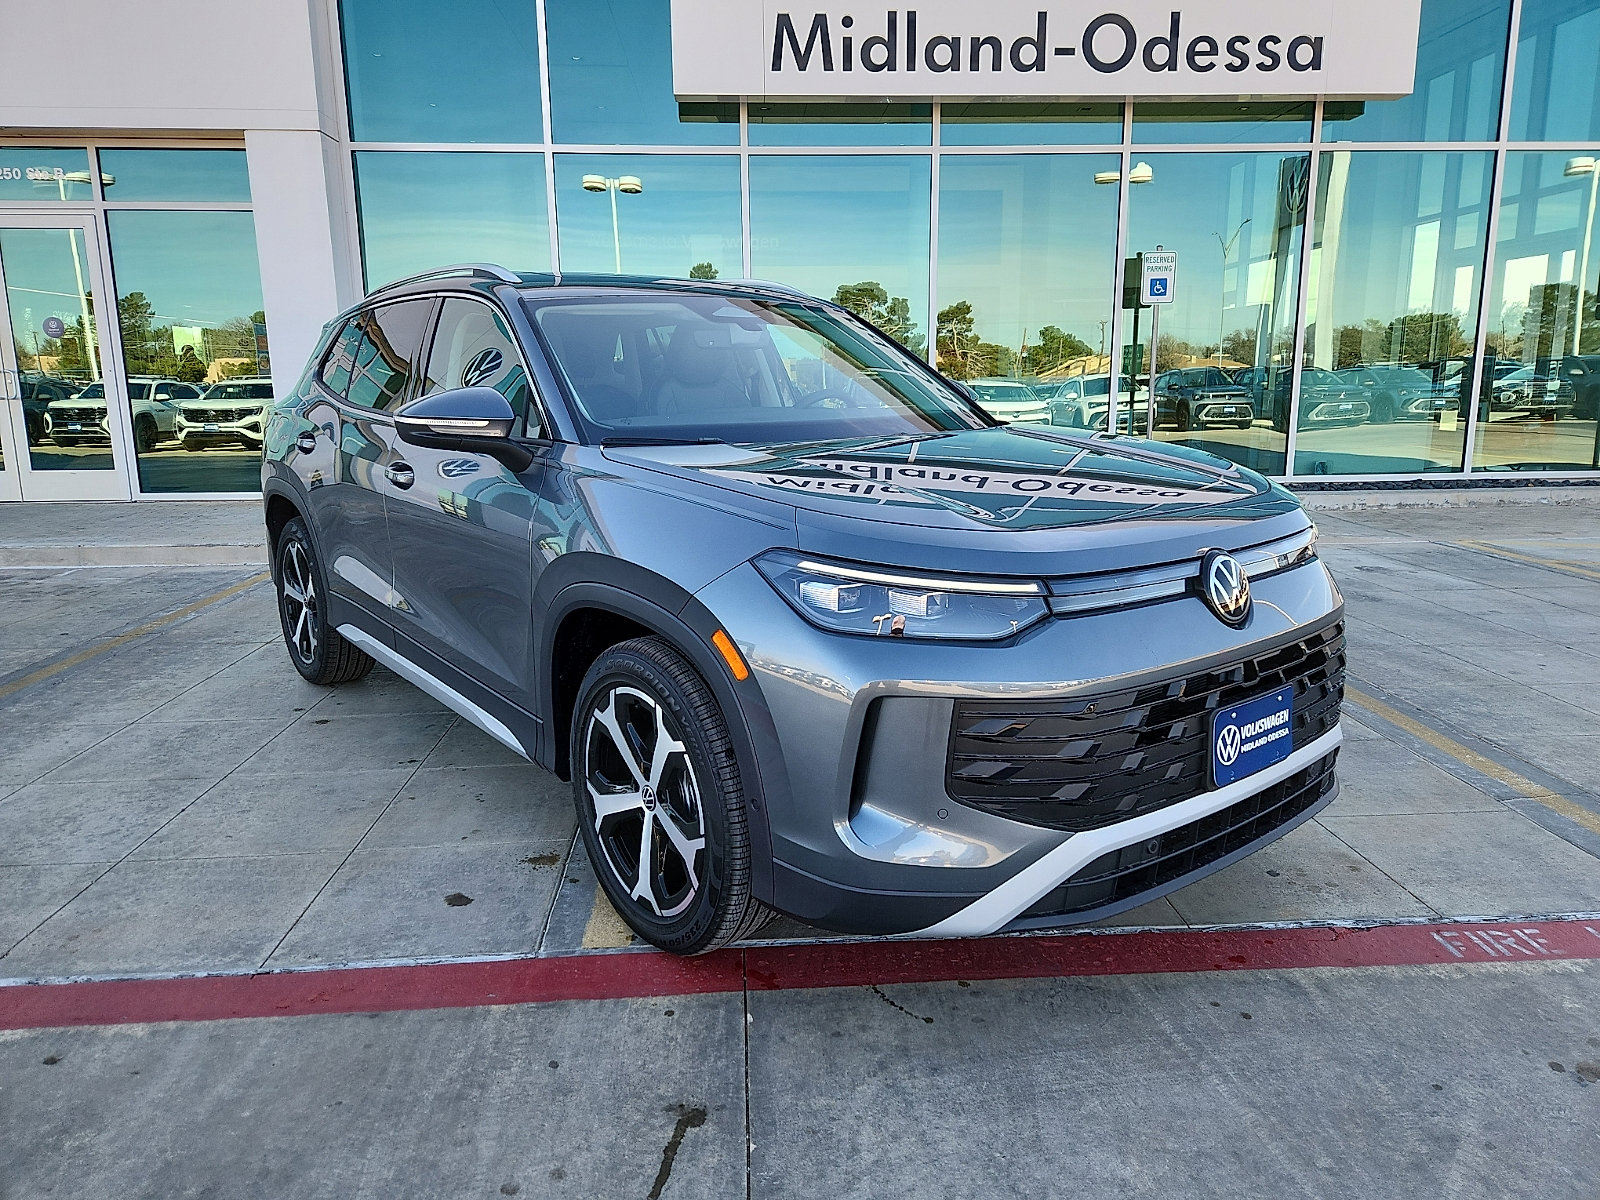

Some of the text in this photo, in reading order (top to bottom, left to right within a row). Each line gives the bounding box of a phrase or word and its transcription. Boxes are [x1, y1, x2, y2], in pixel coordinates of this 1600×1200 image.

[772, 11, 1324, 74] Midland-Odessa
[584, 234, 657, 247] Wecome
[1145, 255, 1175, 264] RESERVED
[1146, 265, 1173, 273] PARKING
[604, 657, 681, 712] SCORPION
[1240, 708, 1290, 740] VOLKSWAGEN
[1240, 727, 1290, 754] MIDLAND ODESSA
[1429, 928, 1568, 958] FIRE
